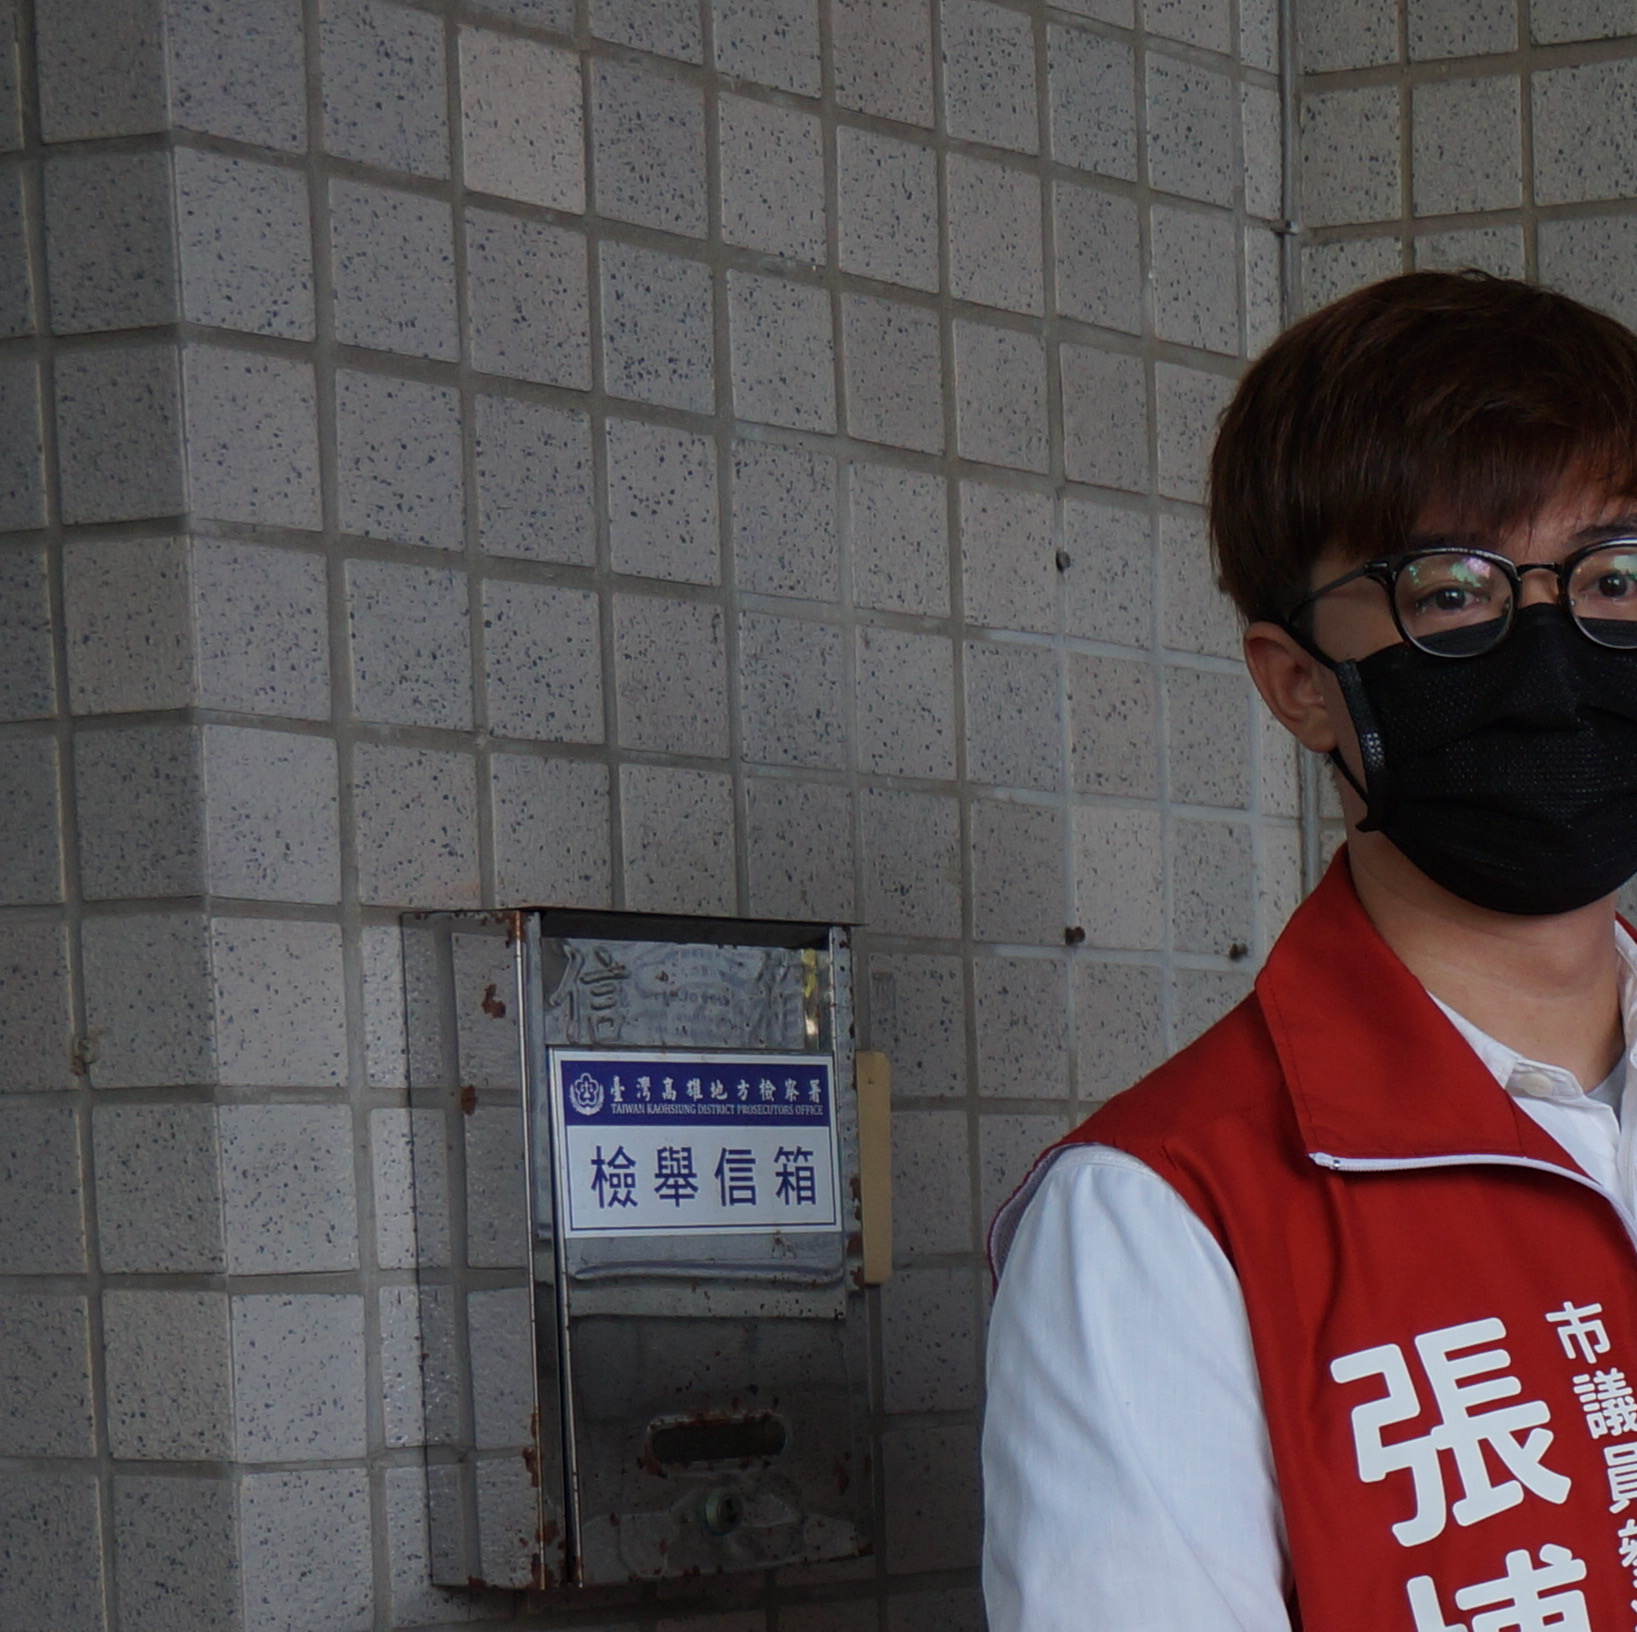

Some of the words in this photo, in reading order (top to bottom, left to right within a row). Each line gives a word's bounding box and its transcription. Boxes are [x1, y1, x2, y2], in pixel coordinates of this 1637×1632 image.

[611, 1103, 645, 1115] TAIWAN
[591, 1145, 817, 1208] 檢舉信箱
